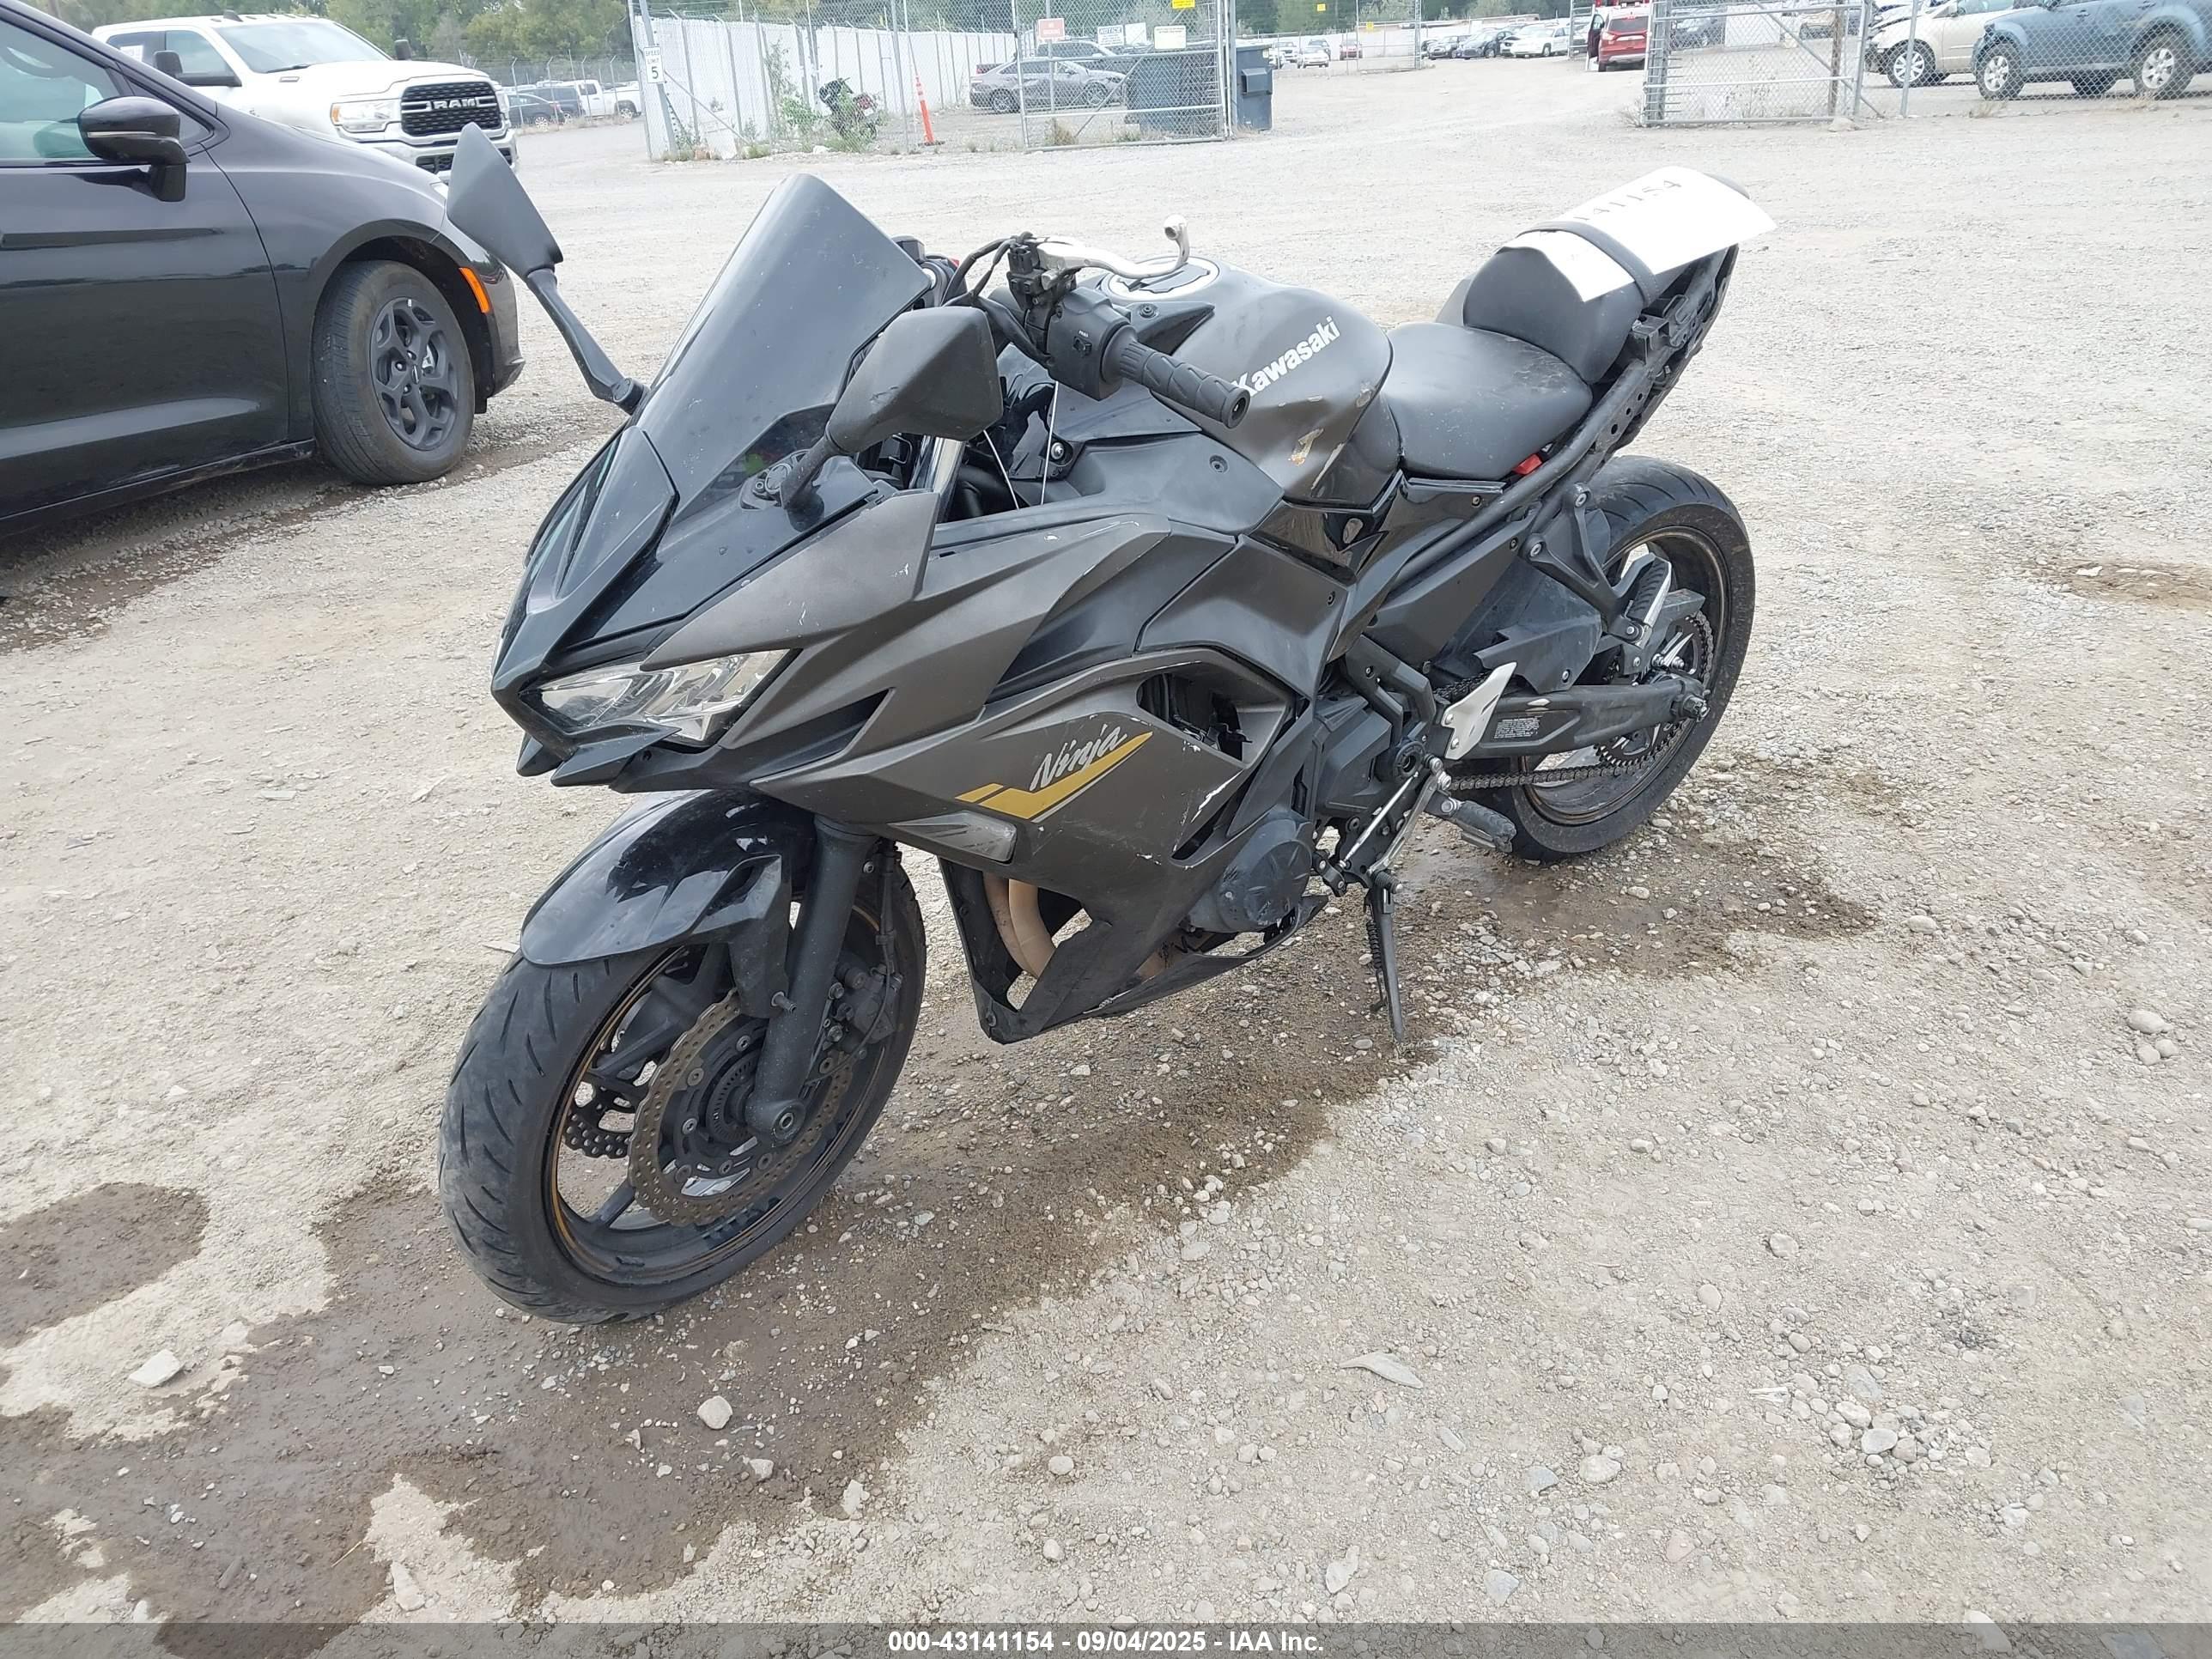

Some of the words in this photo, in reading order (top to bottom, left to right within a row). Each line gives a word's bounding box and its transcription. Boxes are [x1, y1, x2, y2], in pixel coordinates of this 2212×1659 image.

[651, 66, 659, 79] 5
[433, 99, 476, 109] RAM
[1231, 315, 1341, 397] Kawasaki
[1030, 723, 1128, 791] Ninja
